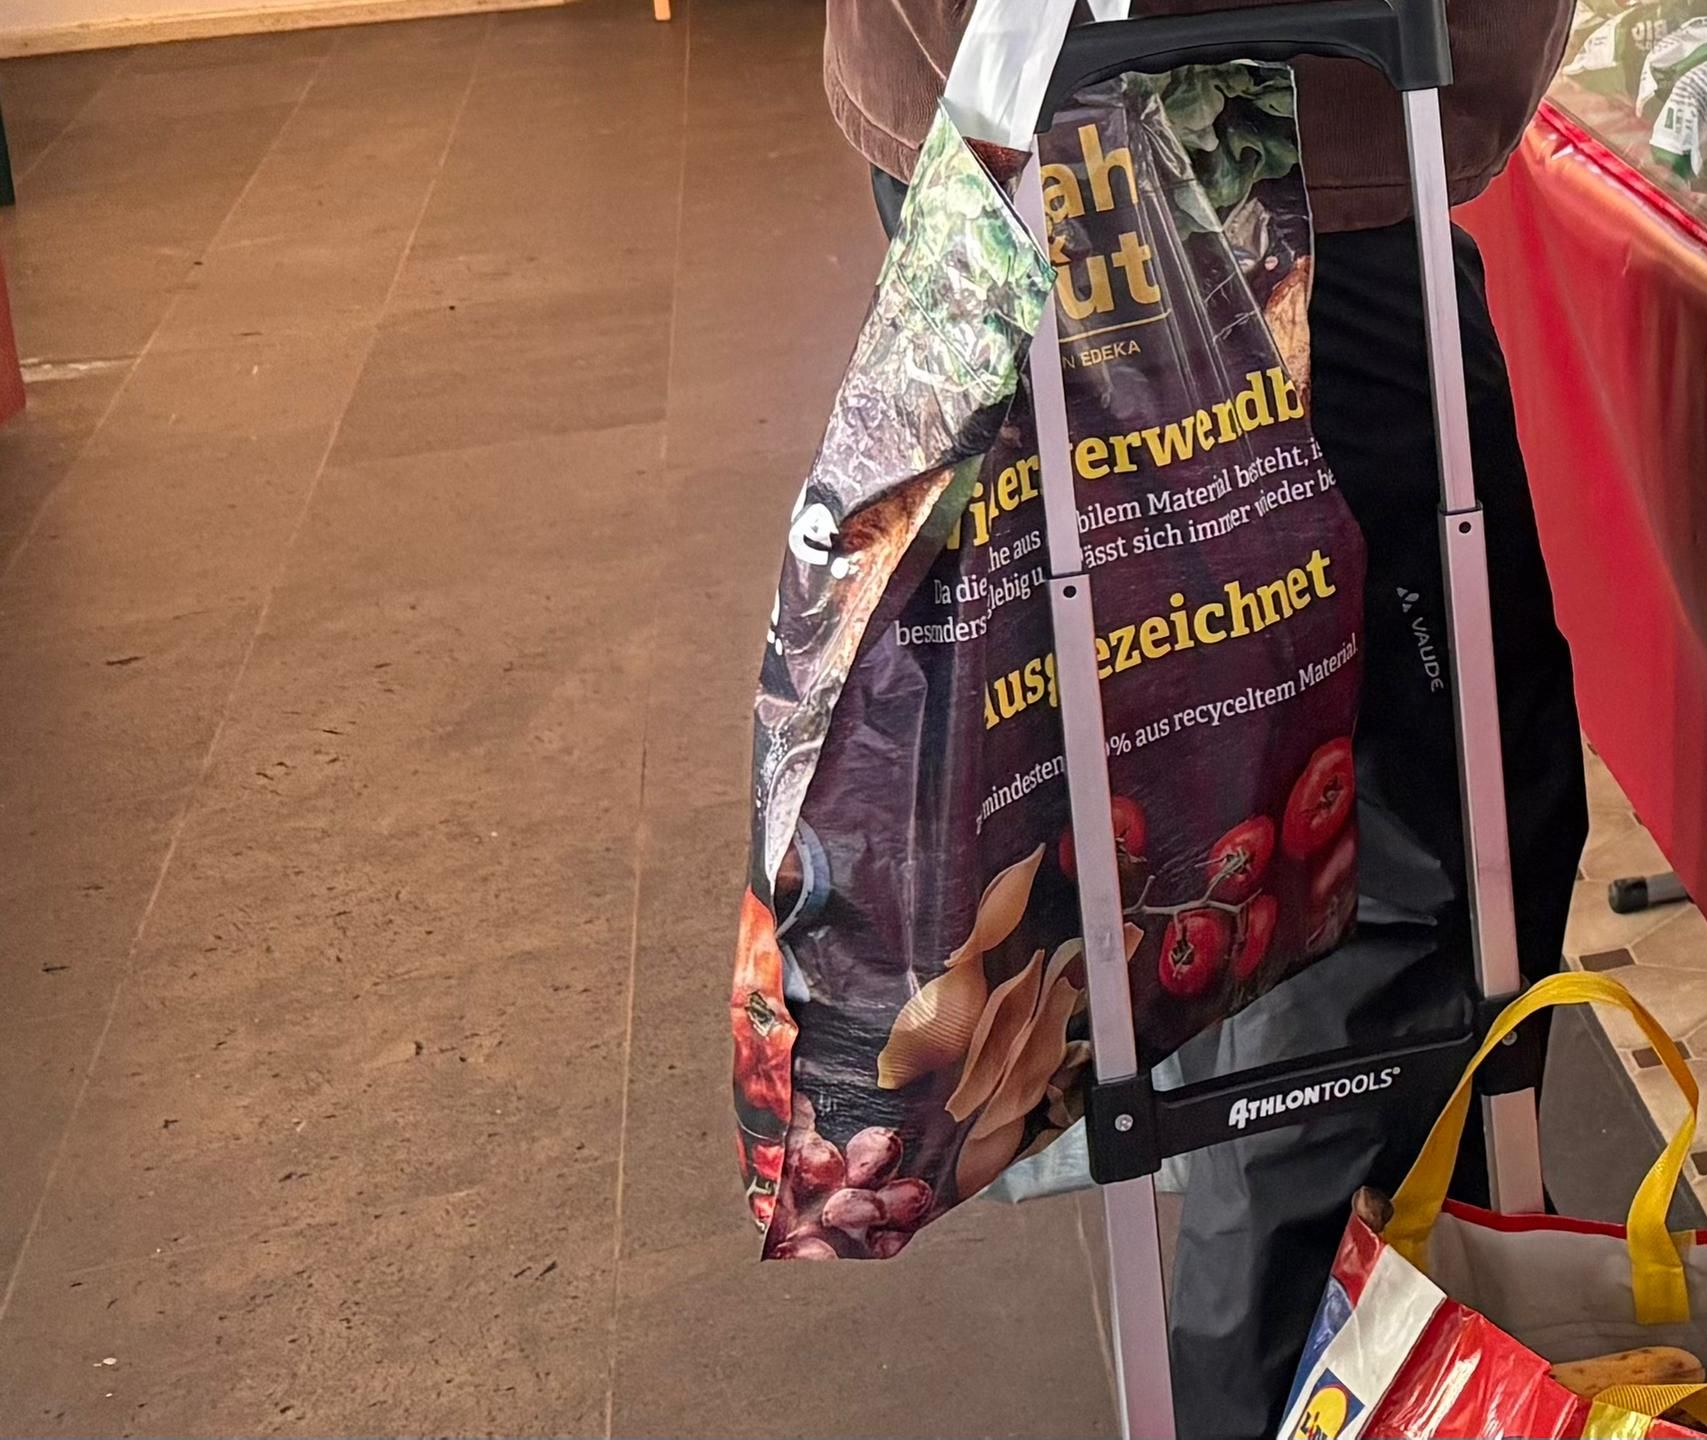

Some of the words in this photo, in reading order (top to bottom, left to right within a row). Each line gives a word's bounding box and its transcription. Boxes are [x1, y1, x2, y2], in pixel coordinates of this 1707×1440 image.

[1056, 231, 1162, 321] ut
[1081, 340, 1142, 368] EDEKA
[1013, 529, 1042, 561] aus
[1075, 497, 1143, 535] bilem
[1083, 537, 1129, 570] ässt
[1132, 523, 1184, 558] sich
[1411, 616, 1444, 693] VAUDE
[1135, 718, 1171, 748] aus
[1174, 681, 1297, 733] recyceltem
